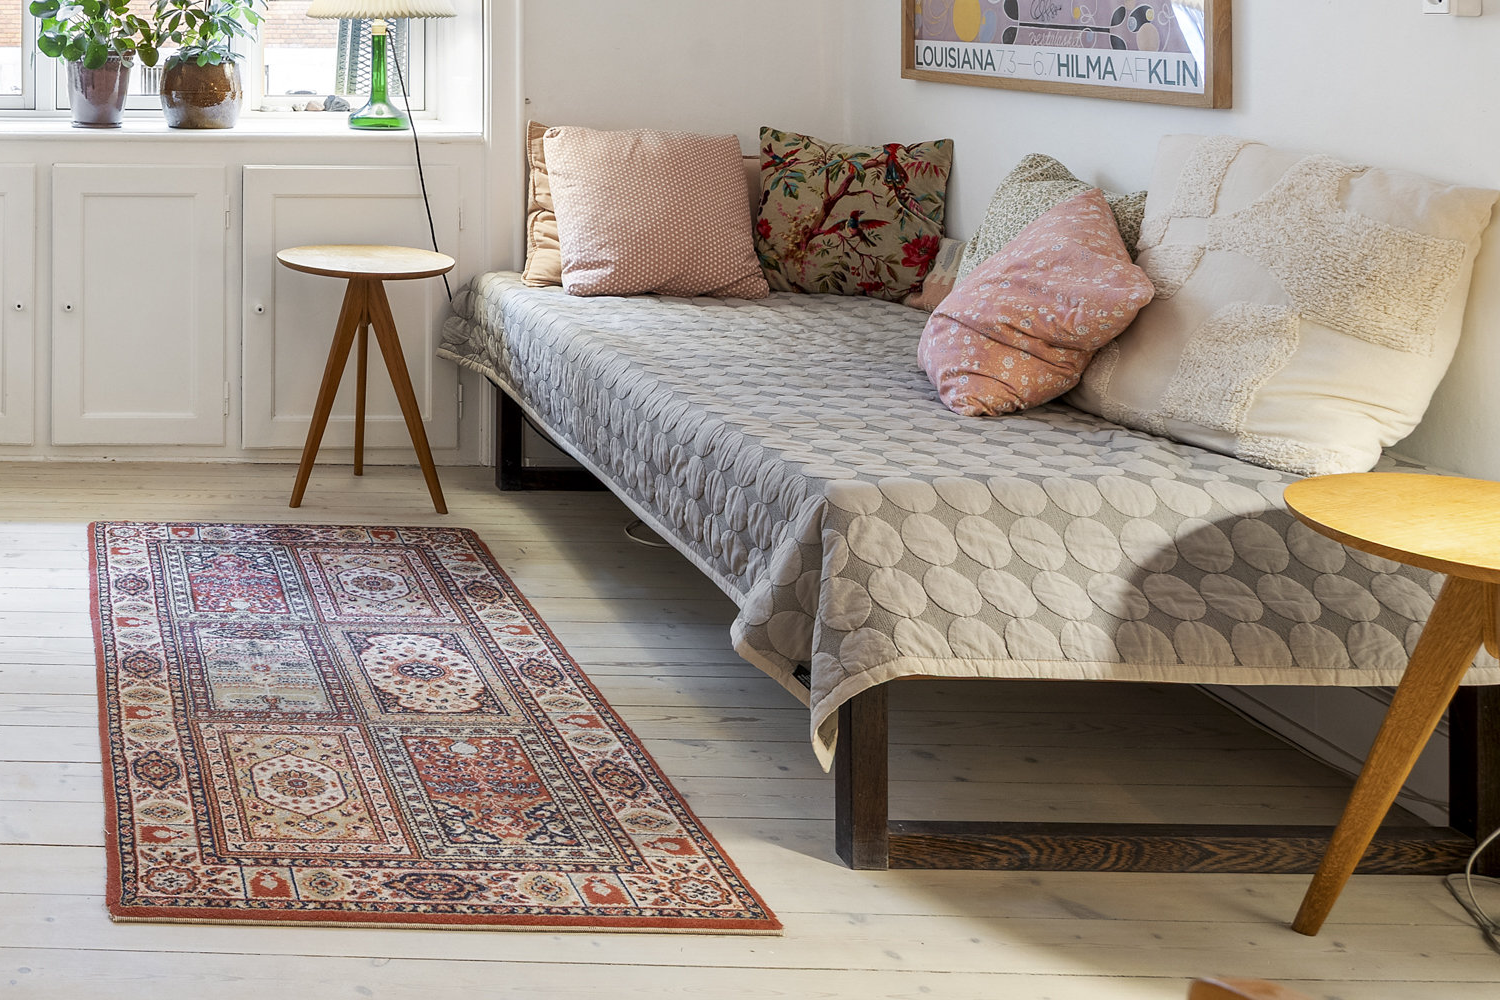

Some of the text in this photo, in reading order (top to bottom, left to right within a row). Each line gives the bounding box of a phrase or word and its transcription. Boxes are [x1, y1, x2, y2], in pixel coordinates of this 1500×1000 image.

[916, 45, 996, 71] LOUISIANA
[1057, 54, 1117, 81] HILMA
[1119, 57, 1147, 82] AF
[1148, 59, 1198, 87] KLIN
